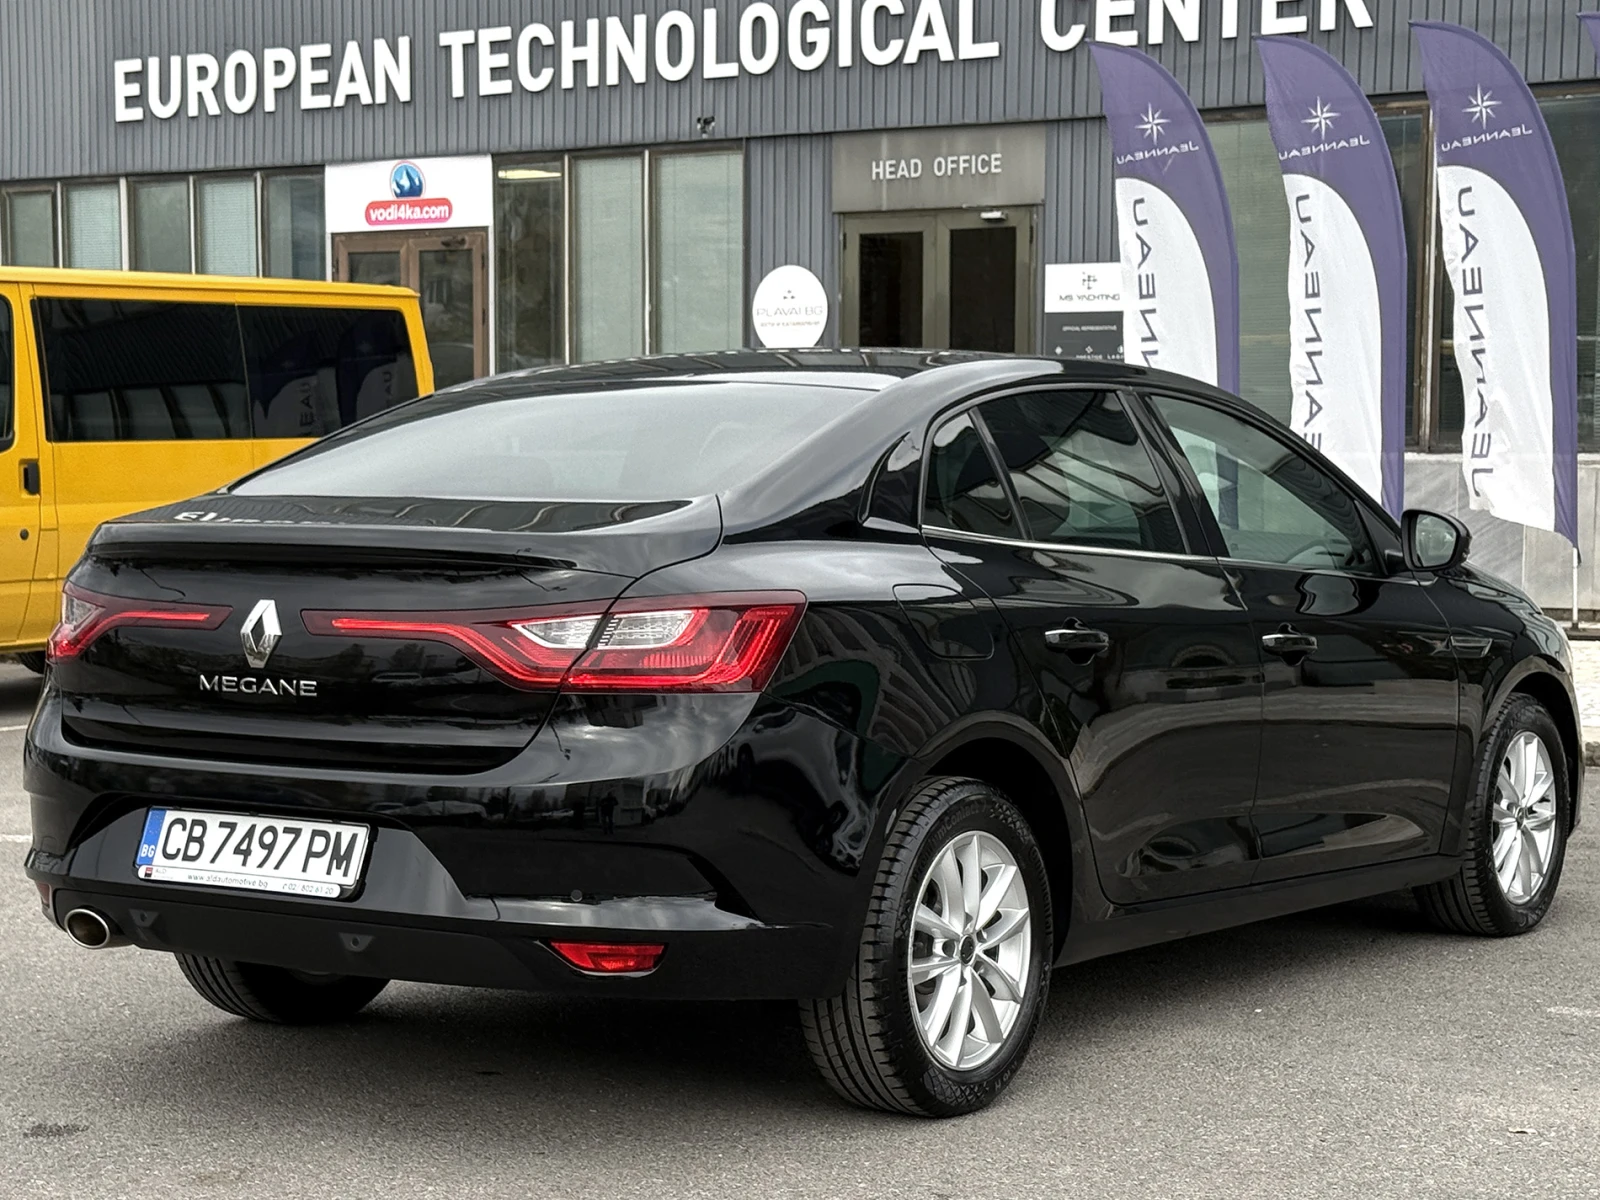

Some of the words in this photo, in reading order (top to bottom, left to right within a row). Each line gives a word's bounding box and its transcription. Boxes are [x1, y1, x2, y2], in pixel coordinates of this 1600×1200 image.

[114, 35, 411, 123] EUROPEAN
[439, 0, 999, 98] TECHNOLOGICAL
[872, 159, 922, 180] HEAD
[933, 153, 1002, 177] OFFICE
[370, 203, 449, 221] vodi4ka.com
[1076, 293, 1120, 301] YACHTING
[200, 674, 317, 697] MEGANE
[140, 844, 155, 858] BG
[162, 817, 207, 862] CB
[209, 820, 303, 871] 7497
[302, 828, 358, 878] PM
[187, 873, 269, 889] www.aldautomotive.bg
